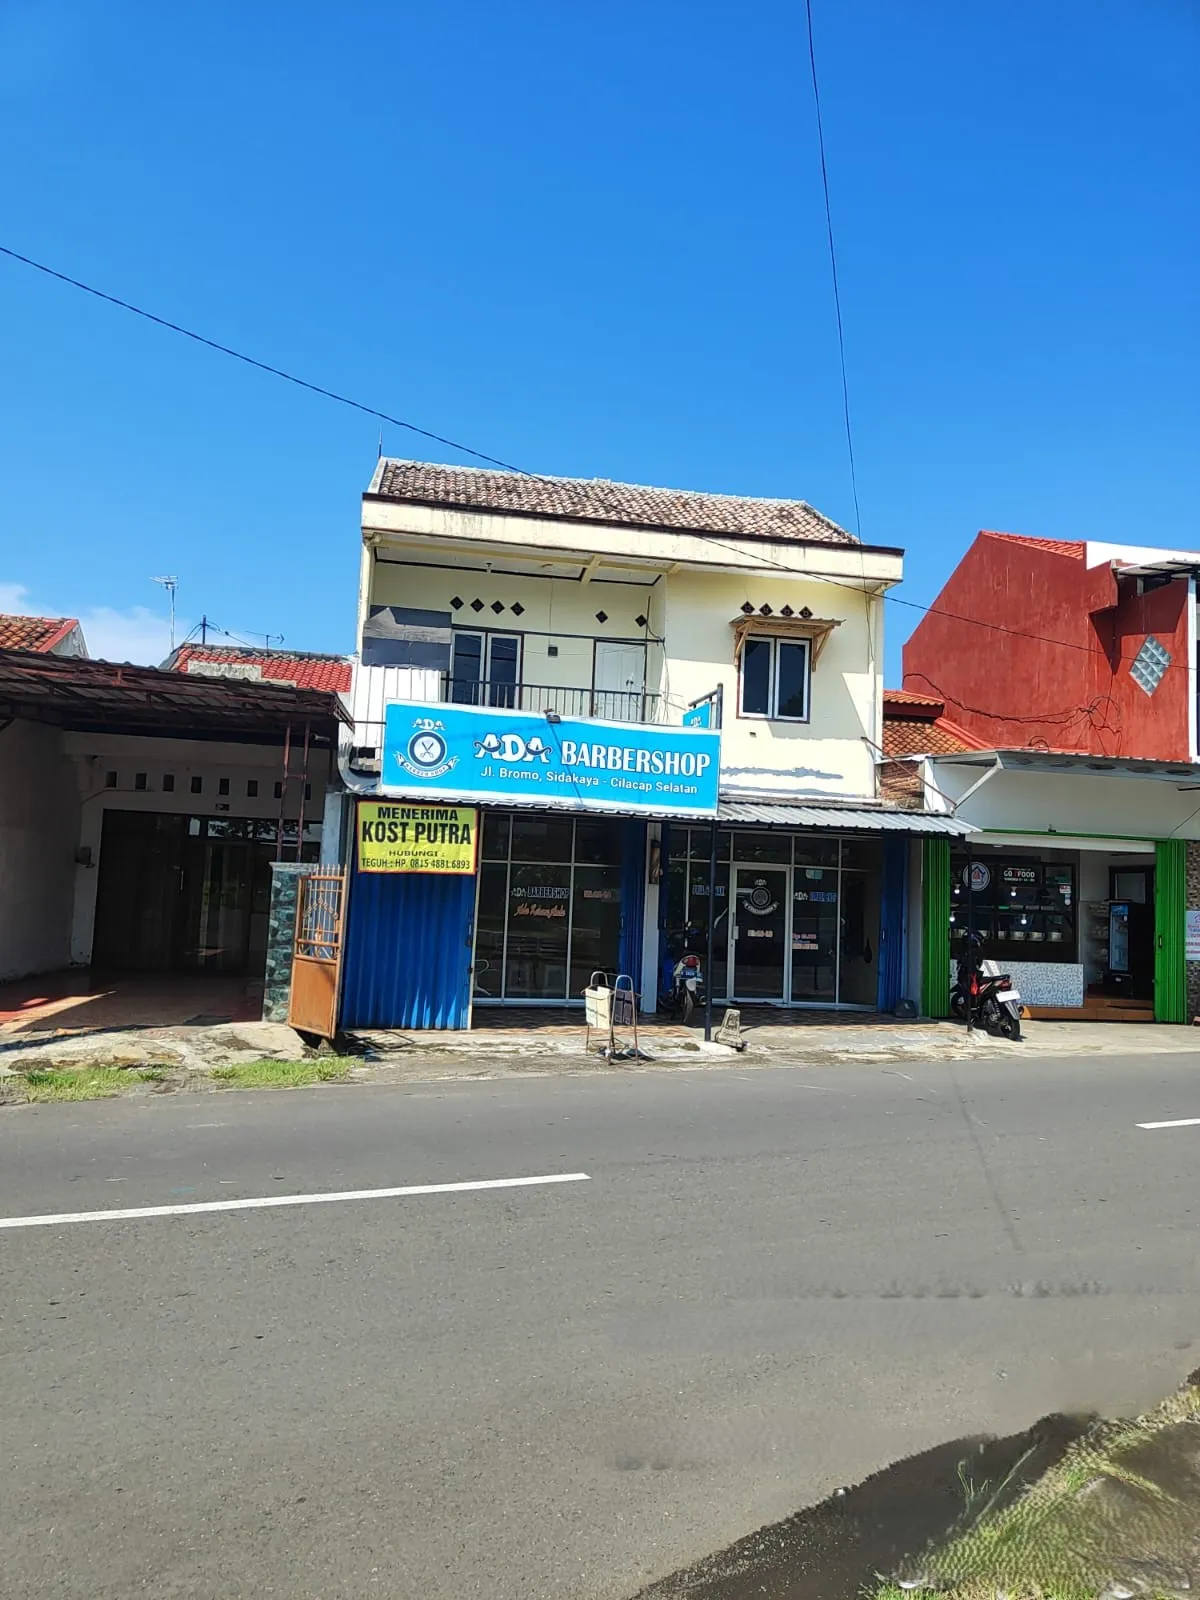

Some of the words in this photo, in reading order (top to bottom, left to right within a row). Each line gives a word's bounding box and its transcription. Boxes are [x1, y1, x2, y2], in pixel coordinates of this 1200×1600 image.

[412, 717, 447, 731] ADA
[473, 732, 552, 764] ADA
[561, 740, 711, 777] BARBERSHOP
[480, 765, 495, 777] Jl.
[499, 767, 543, 783] Bromo,
[546, 771, 599, 786] Sidakaya
[610, 777, 653, 793] Cilacap
[655, 782, 698, 794] Selatan
[377, 806, 459, 821] MENERIMA
[362, 820, 410, 843] KOST
[414, 822, 472, 845] PUTRA
